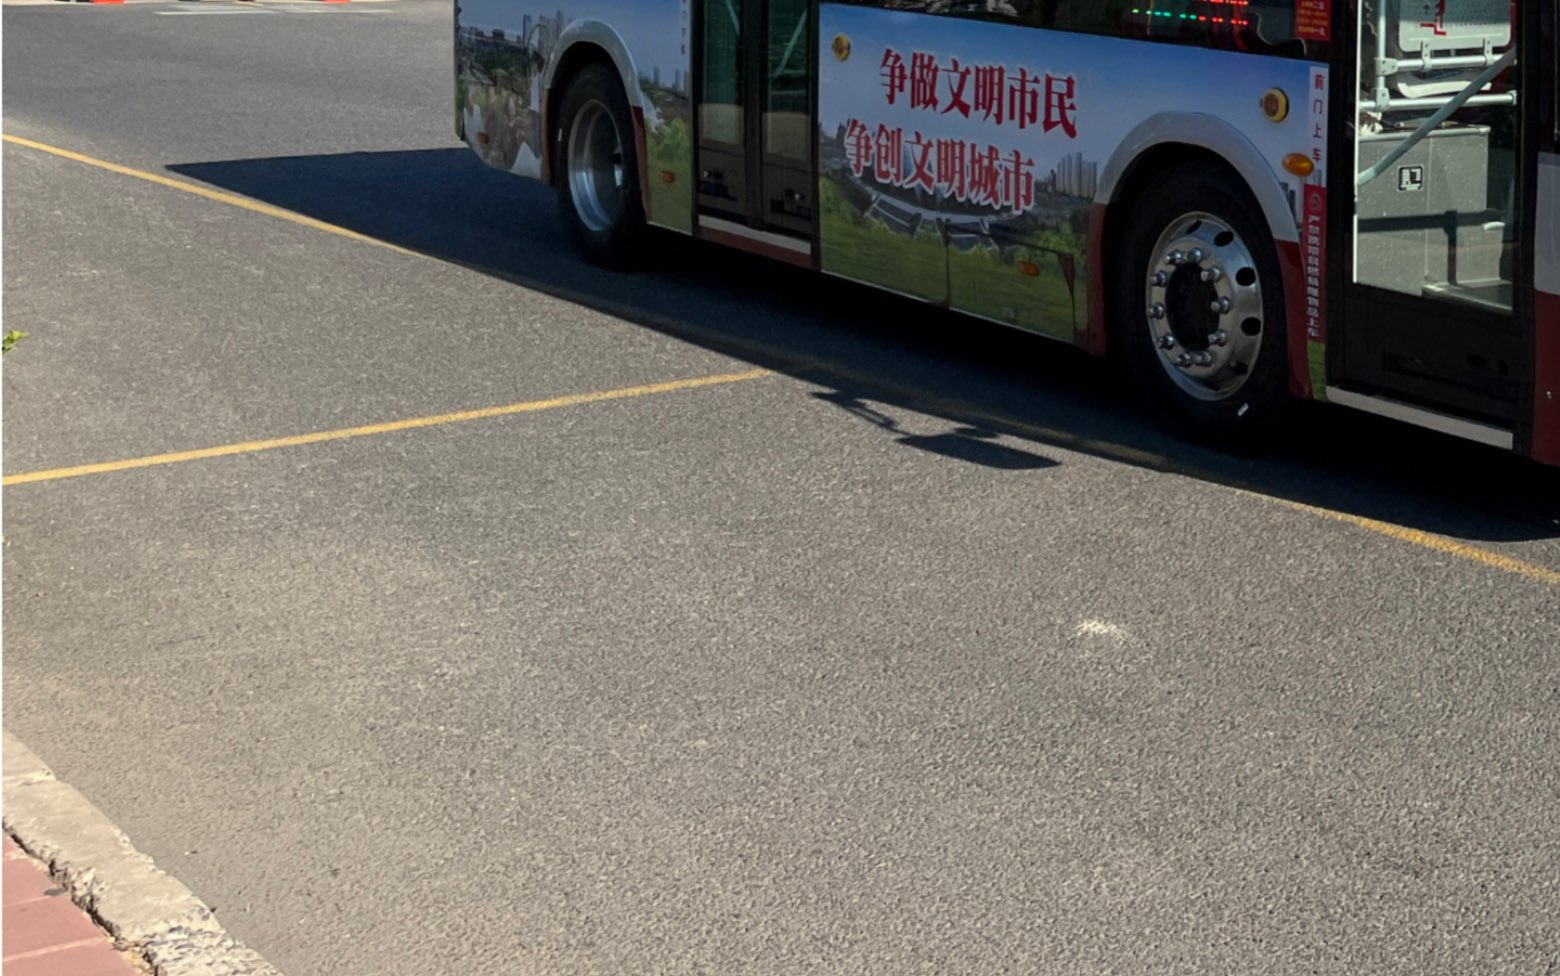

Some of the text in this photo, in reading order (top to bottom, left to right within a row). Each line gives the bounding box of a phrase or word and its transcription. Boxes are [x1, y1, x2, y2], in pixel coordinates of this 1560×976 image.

[880, 48, 1077, 139] 争做文明市民
[1312, 74, 1324, 161] 前门上车
[847, 118, 1035, 214] 争创文明城市
